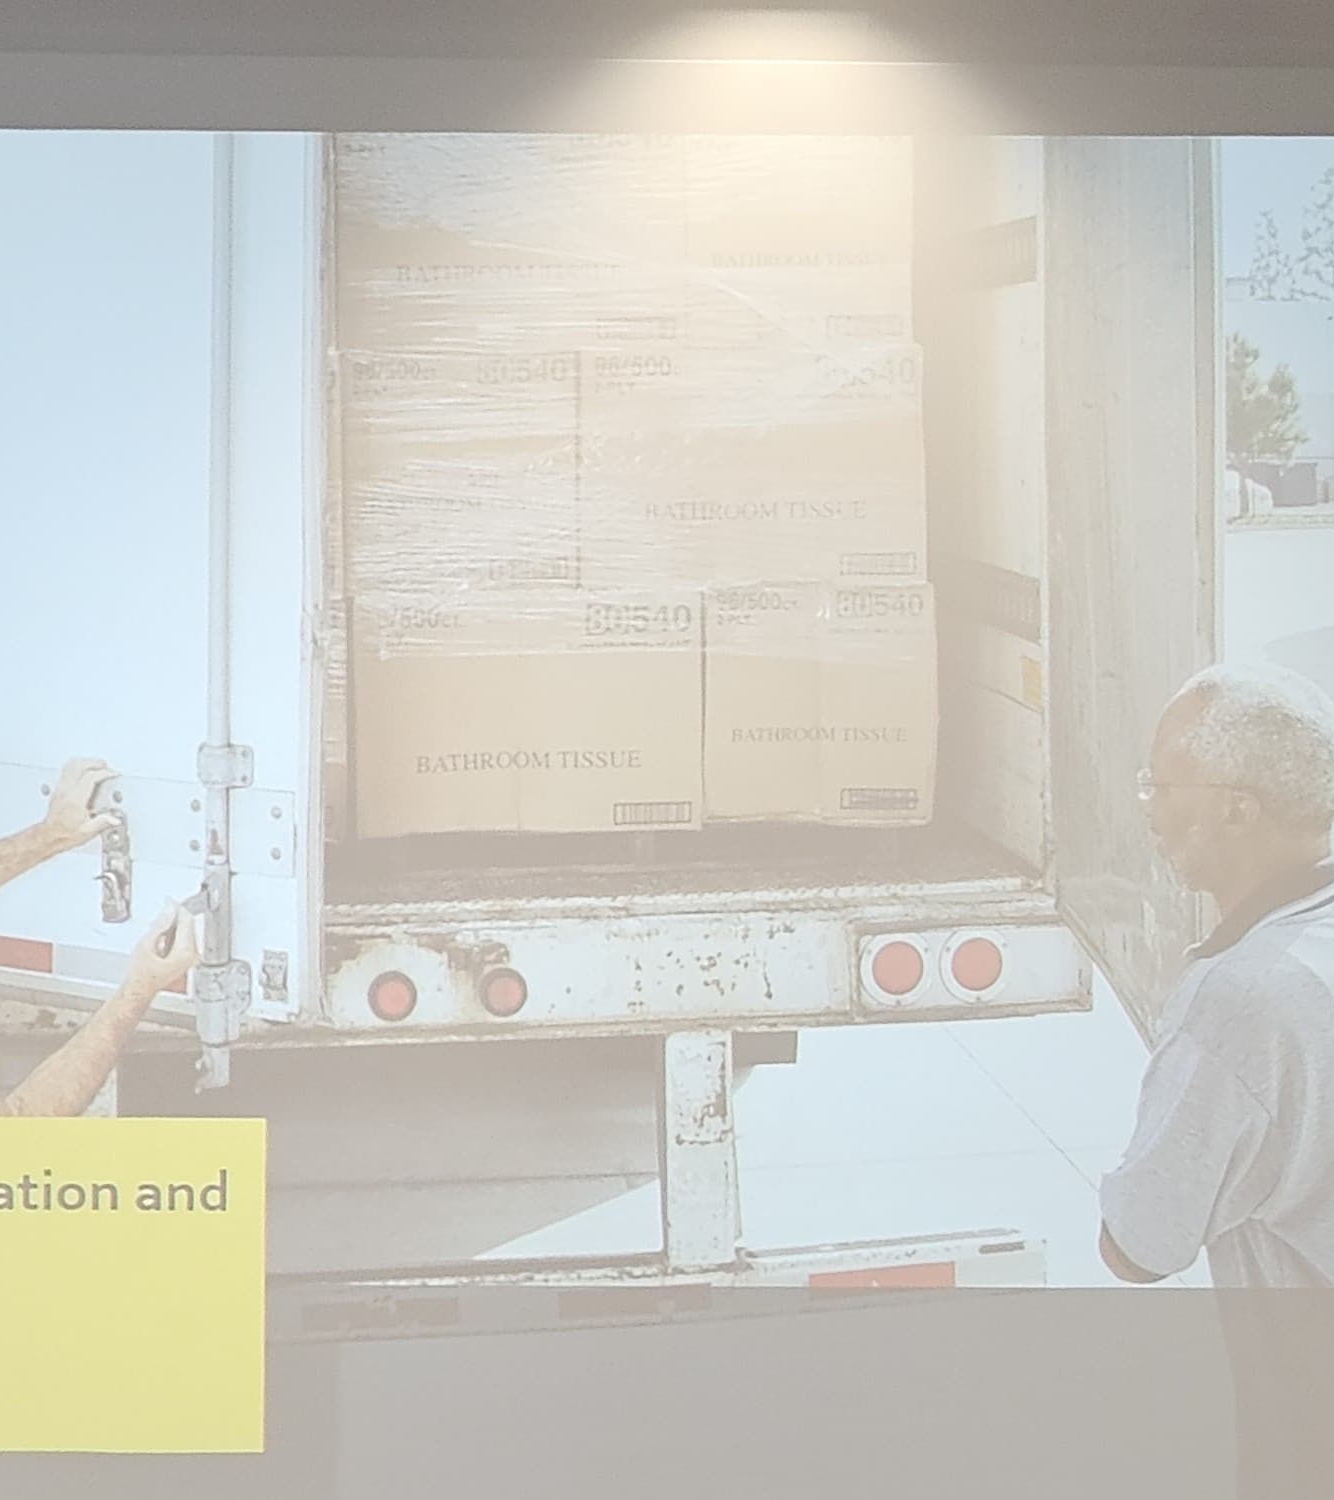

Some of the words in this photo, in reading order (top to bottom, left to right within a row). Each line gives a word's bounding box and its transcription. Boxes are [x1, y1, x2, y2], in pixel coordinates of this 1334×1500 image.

[644, 501, 779, 522] BATHROOM
[730, 726, 837, 744] BATHROOM
[841, 726, 908, 744] TISSUE
[415, 750, 550, 775] BATHROOM
[556, 749, 643, 770] TISSUE
[134, 1168, 230, 1212] and
